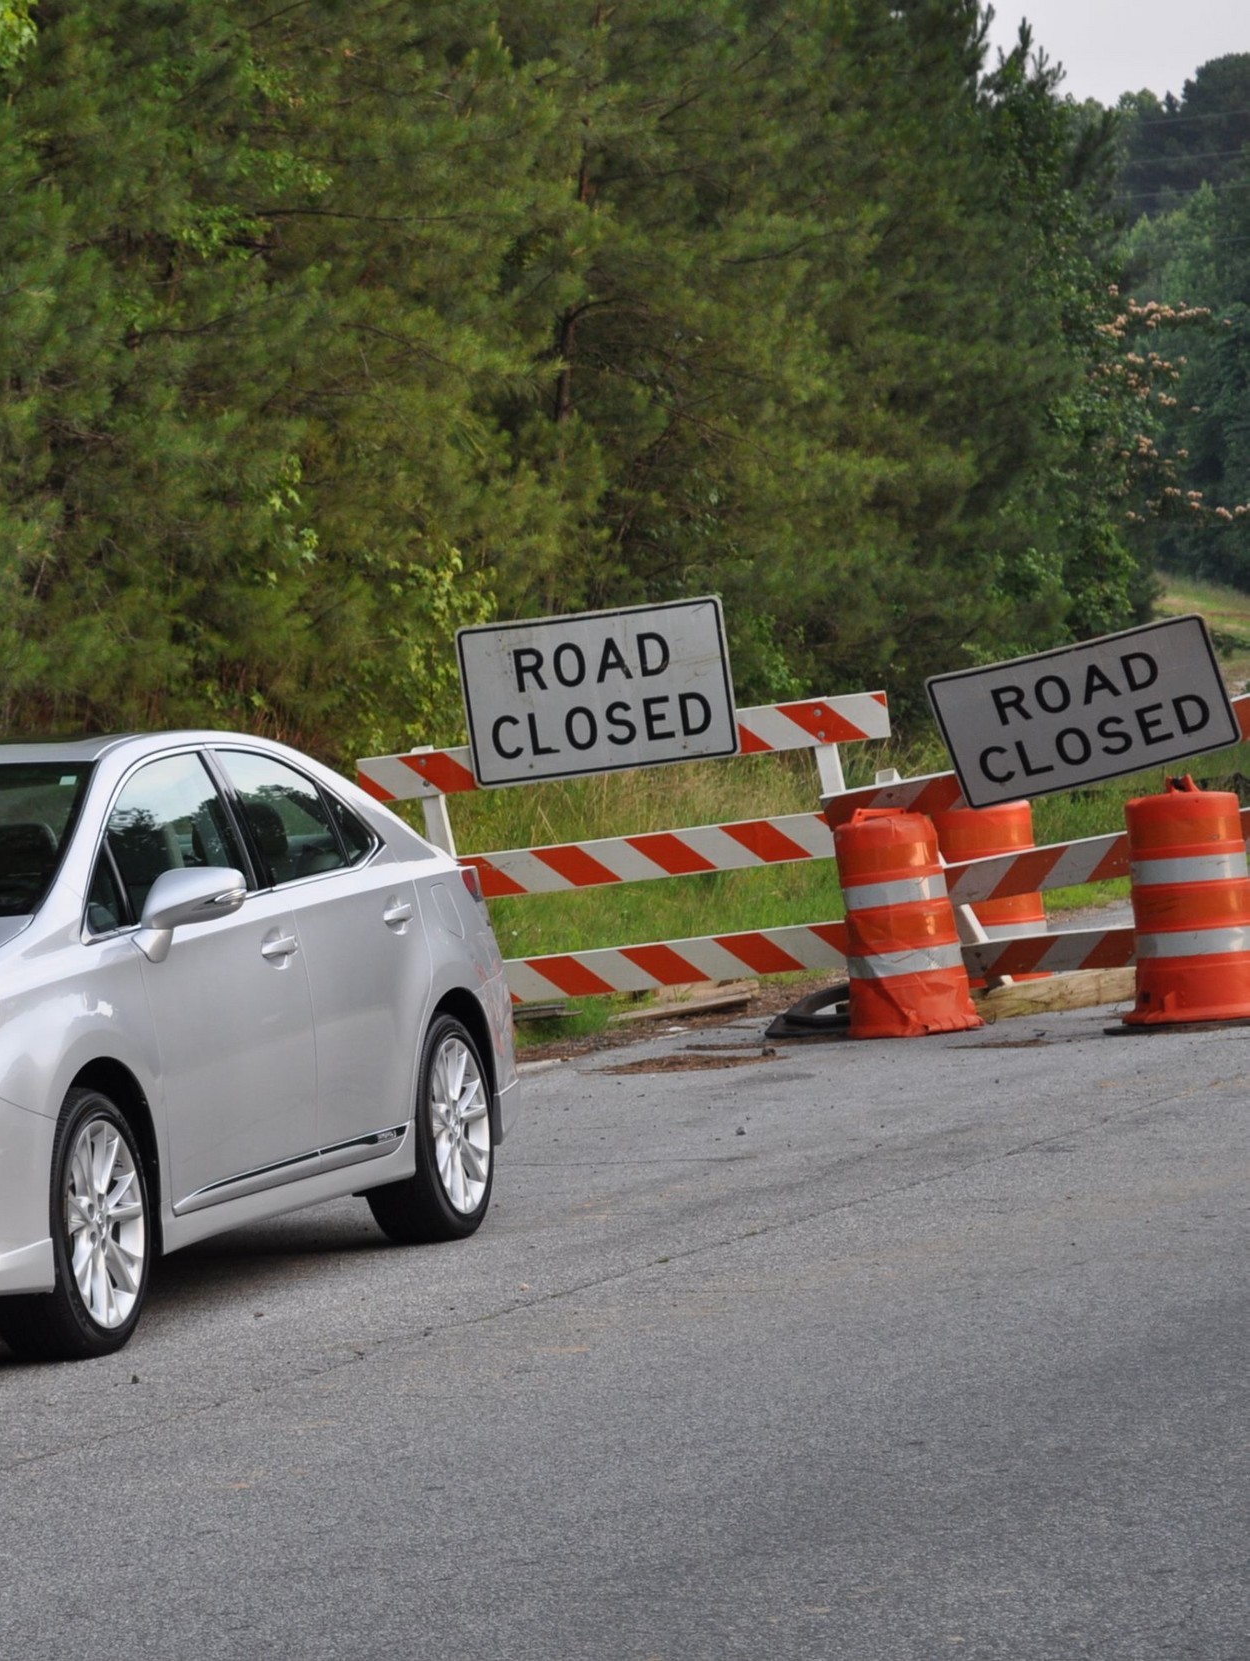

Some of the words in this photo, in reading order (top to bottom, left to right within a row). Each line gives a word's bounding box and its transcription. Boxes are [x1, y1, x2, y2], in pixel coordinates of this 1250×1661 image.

[513, 631, 670, 694] ROAD
[990, 651, 1161, 727] ROAD
[491, 691, 712, 760] CLOSED
[979, 692, 1212, 784] CLOSED
